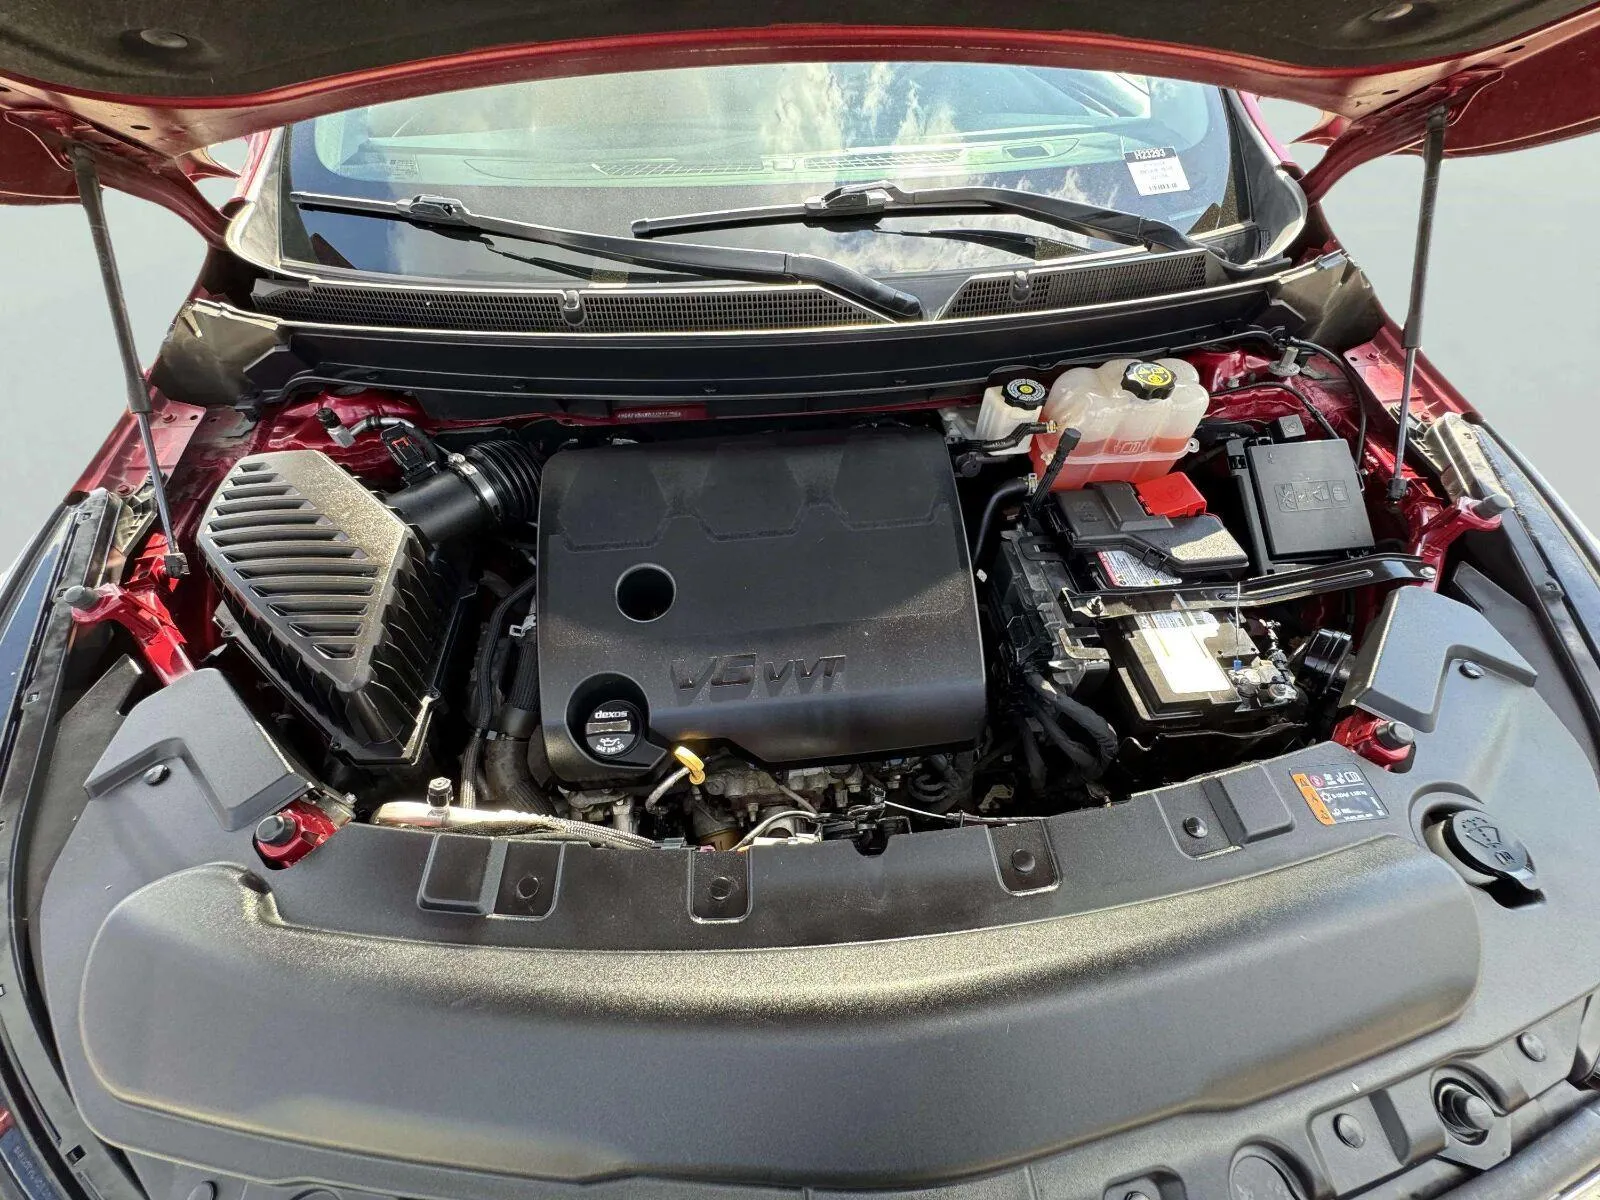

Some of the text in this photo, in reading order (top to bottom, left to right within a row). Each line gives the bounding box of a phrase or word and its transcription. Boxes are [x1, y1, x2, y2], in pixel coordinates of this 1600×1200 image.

[671, 653, 847, 697] V6 VVT
[594, 709, 628, 719] dexos
